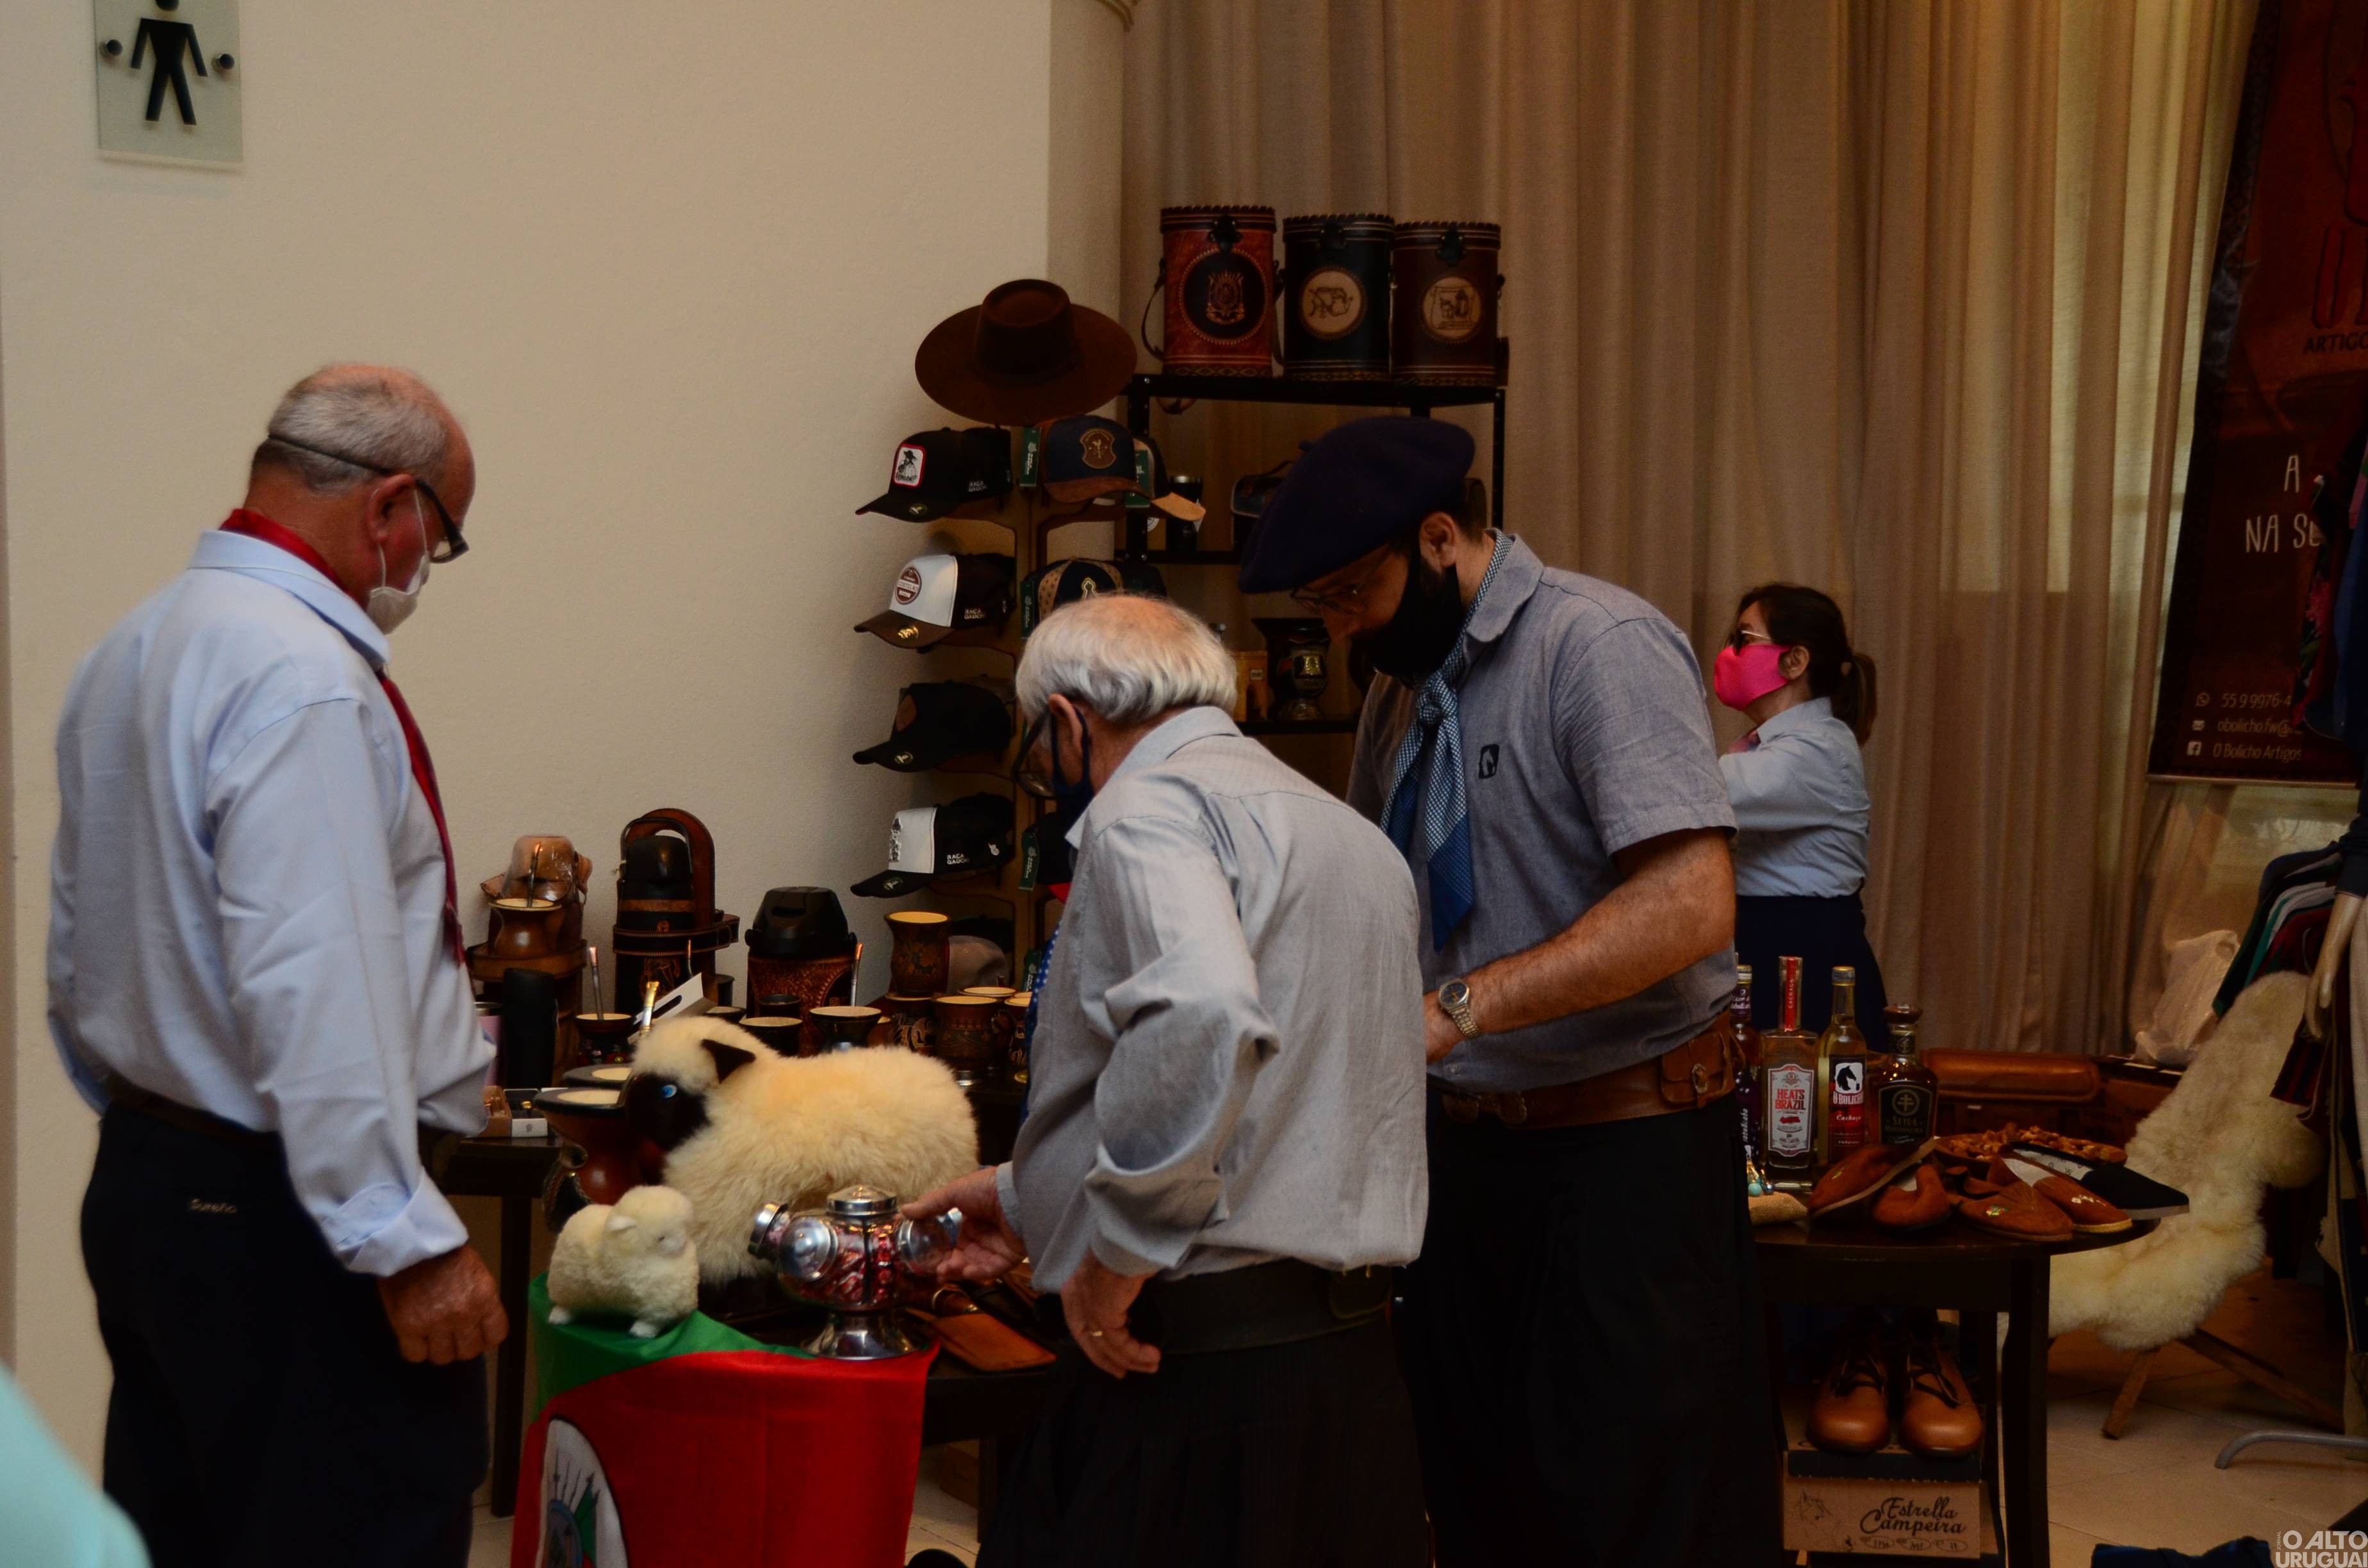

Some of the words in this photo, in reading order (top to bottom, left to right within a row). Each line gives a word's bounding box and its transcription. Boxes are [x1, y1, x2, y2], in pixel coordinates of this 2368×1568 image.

[2246, 514, 2279, 553] NA
[2219, 693, 2237, 708] 55
[2239, 694, 2248, 708] 9
[2223, 743, 2262, 759] Bolicho
[1777, 1089, 1805, 1100] HEATS
[1775, 1098, 1806, 1110] BRAZIL
[1880, 1496, 1959, 1519] Estrella
[1859, 1509, 1966, 1537] Campeira
